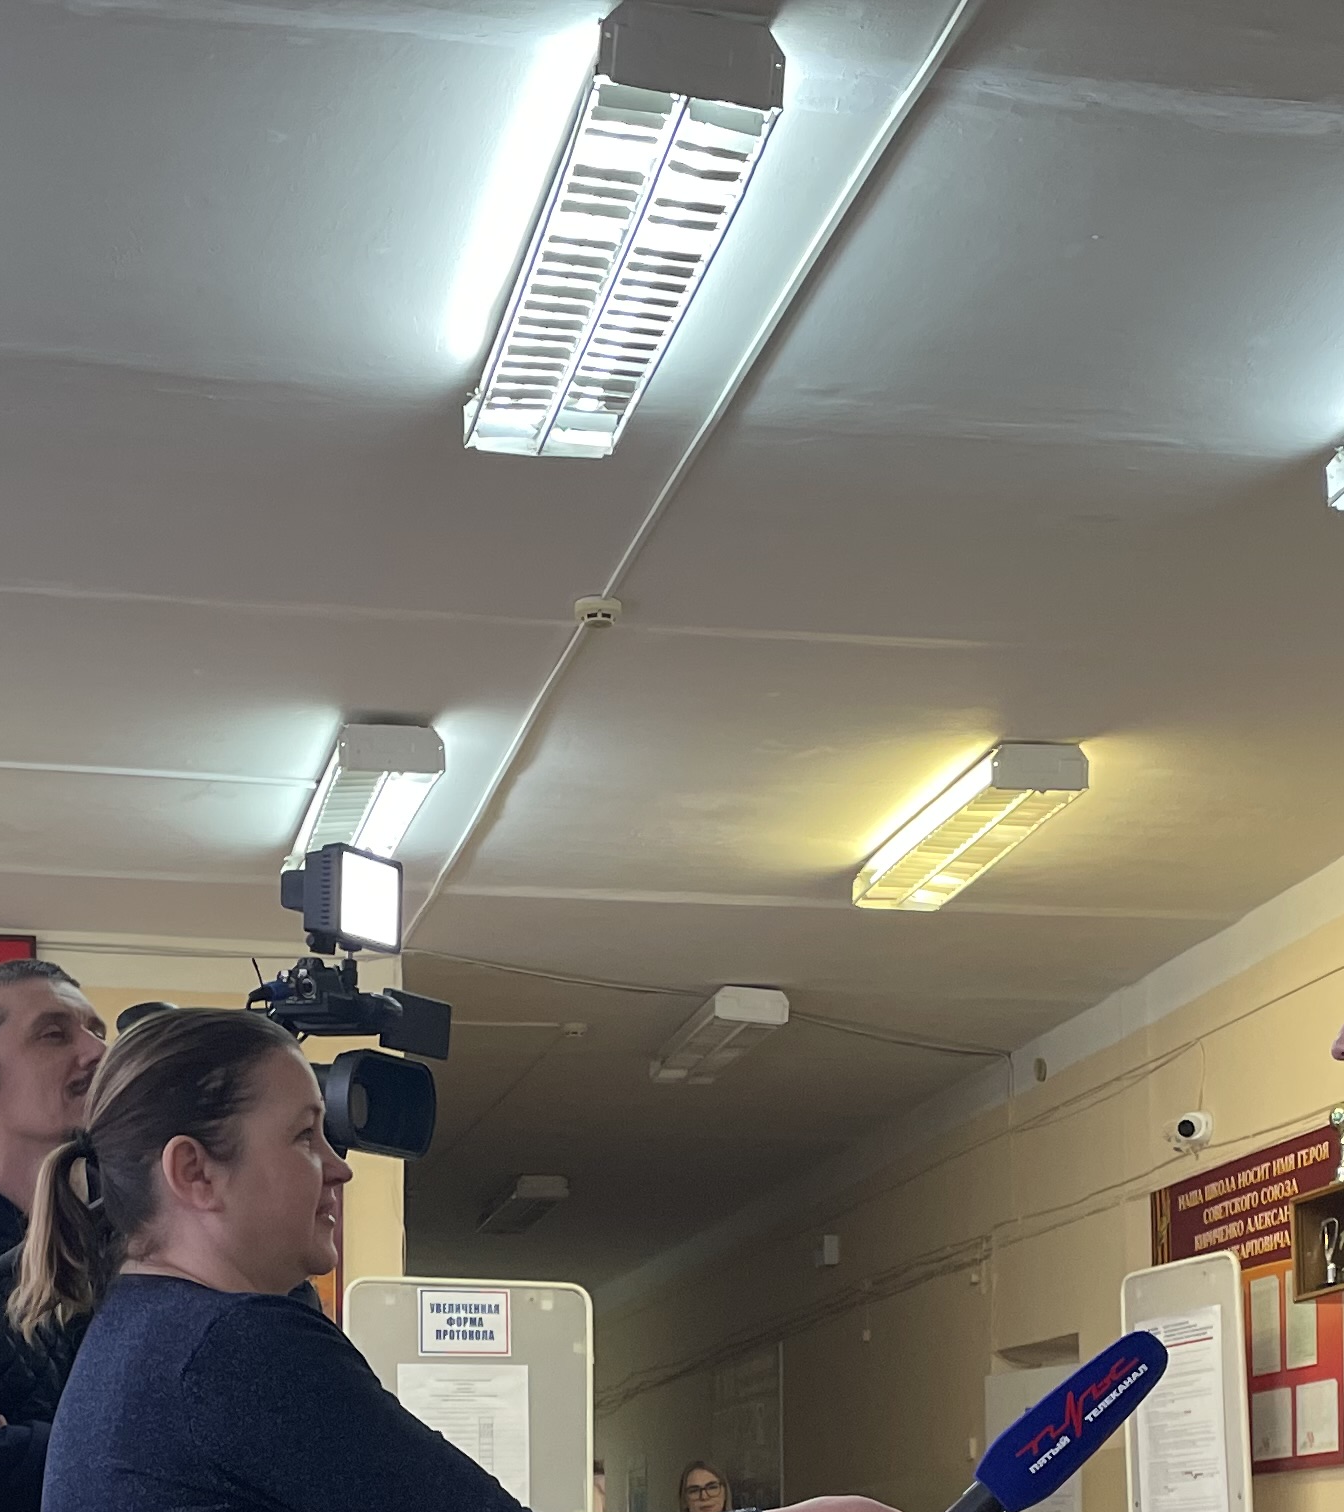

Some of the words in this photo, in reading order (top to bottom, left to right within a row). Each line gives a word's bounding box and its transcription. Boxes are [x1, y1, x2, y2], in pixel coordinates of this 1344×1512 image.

[1178, 1188, 1204, 1212] НАША
[1204, 1175, 1237, 1201] ШКОЛА
[1237, 1162, 1272, 1189] НОСИТ
[1272, 1153, 1296, 1177] ИМЯ
[1297, 1141, 1330, 1169] ГЕРОЯ
[1202, 1191, 1259, 1225] СОВЕТСКОГО
[1260, 1177, 1299, 1205] СОЮЗА
[1246, 1204, 1291, 1234] АЛЕКСАН
[429, 1302, 500, 1314] УВЕЛИЧЕННАЯ
[446, 1316, 484, 1327] ФОРМА
[435, 1329, 495, 1341] ПРОТОКОЛА
[1028, 1435, 1071, 1474] ПЯТЫЙ
[1084, 1363, 1149, 1423] ТЕЛЕКАНАЛ
